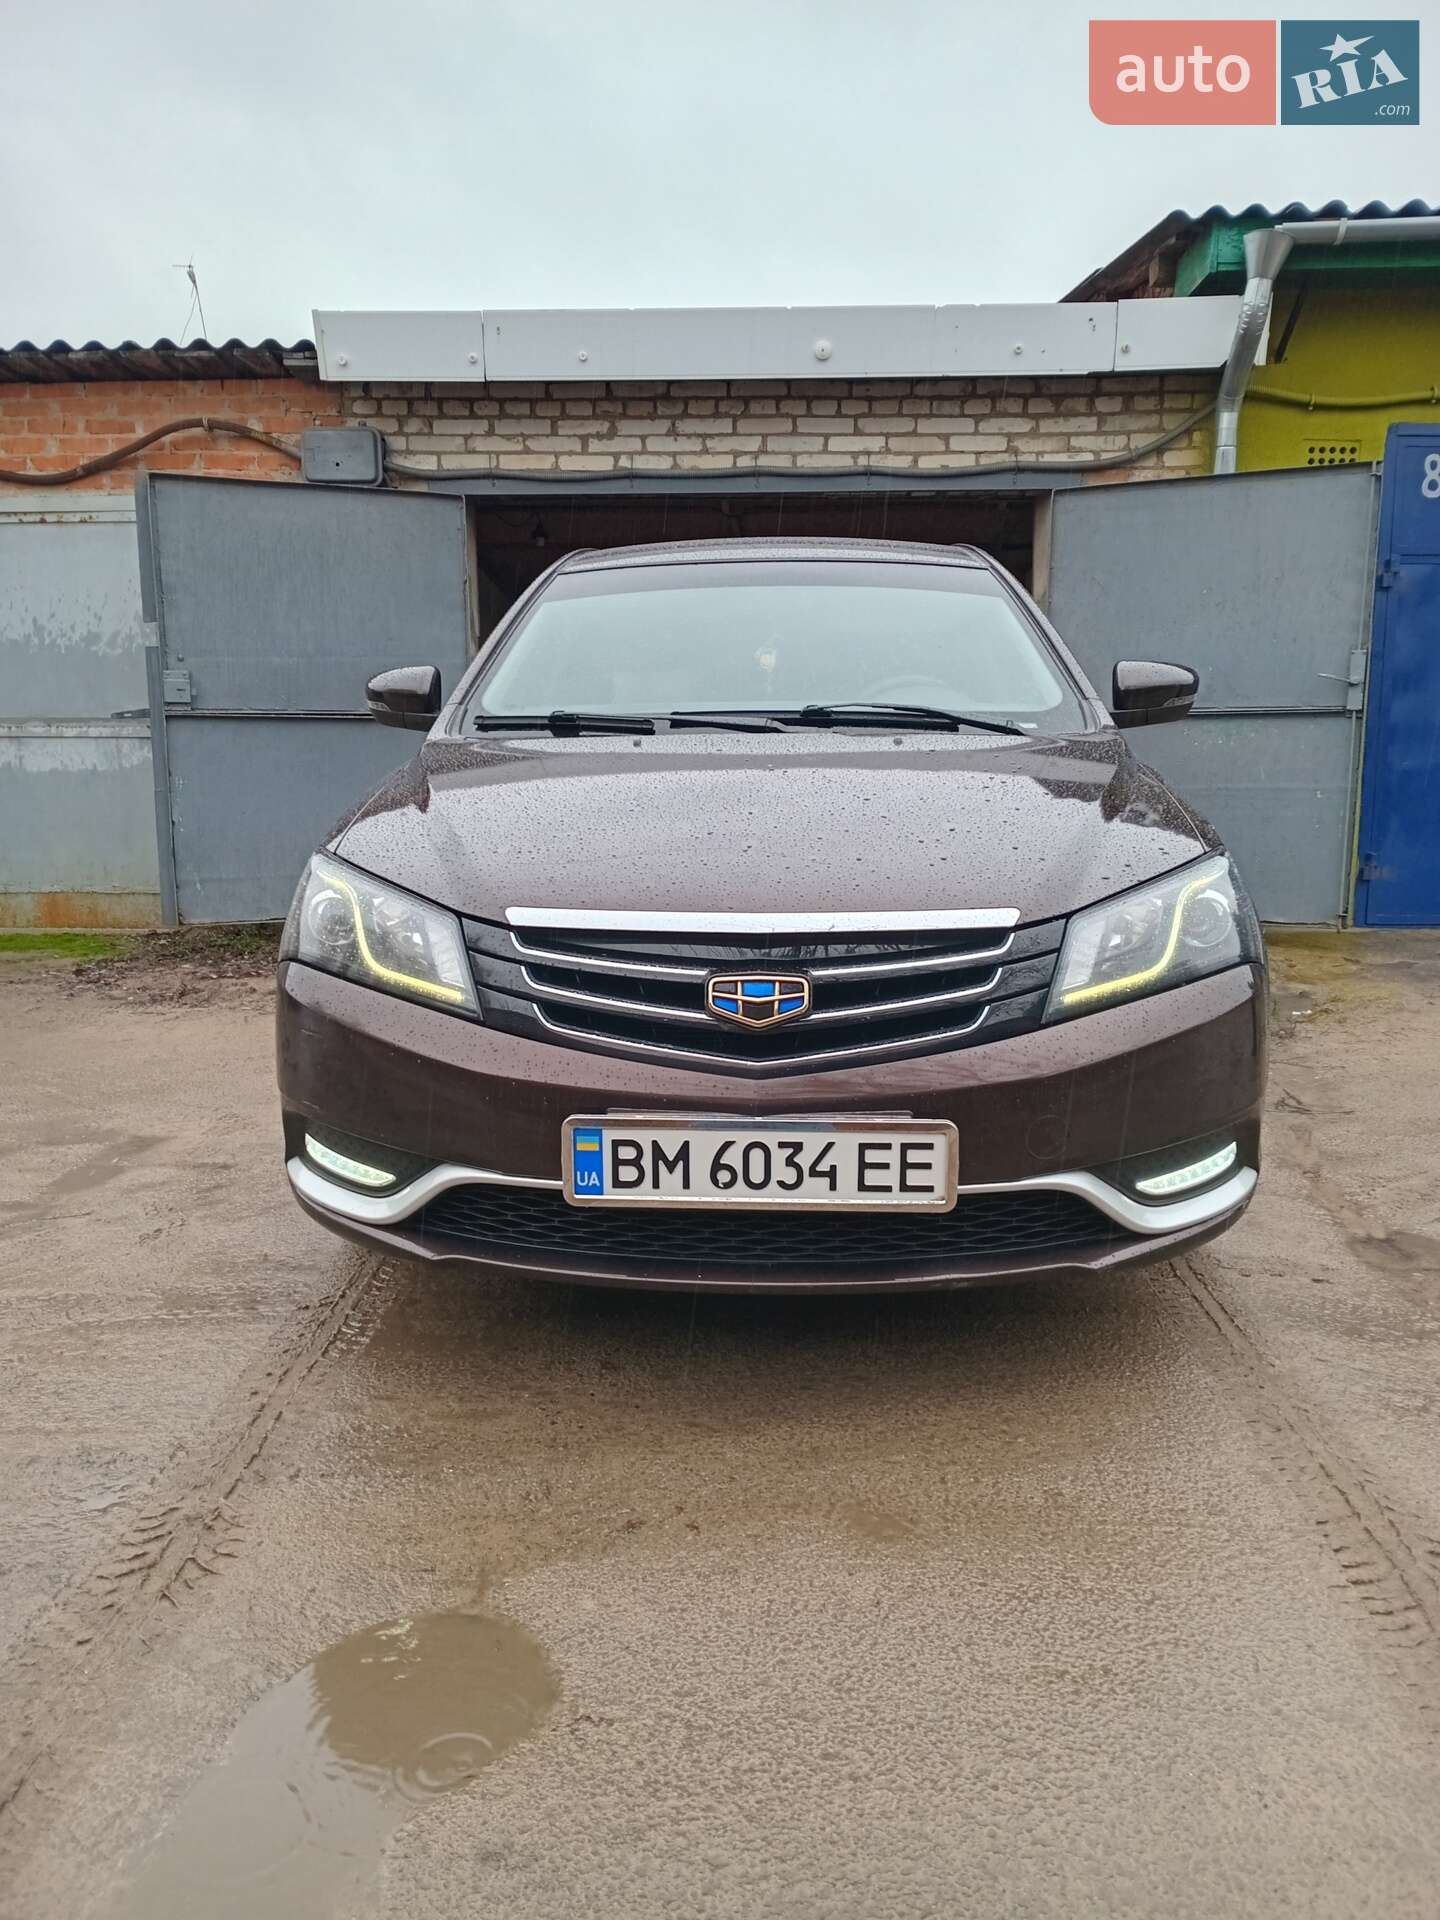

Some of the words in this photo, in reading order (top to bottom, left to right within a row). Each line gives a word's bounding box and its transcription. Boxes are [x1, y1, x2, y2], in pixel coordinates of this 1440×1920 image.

[576, 1171, 600, 1187] UA
[611, 1139, 690, 1190] BM
[709, 1140, 838, 1192] 6034
[857, 1142, 935, 1193] EE
